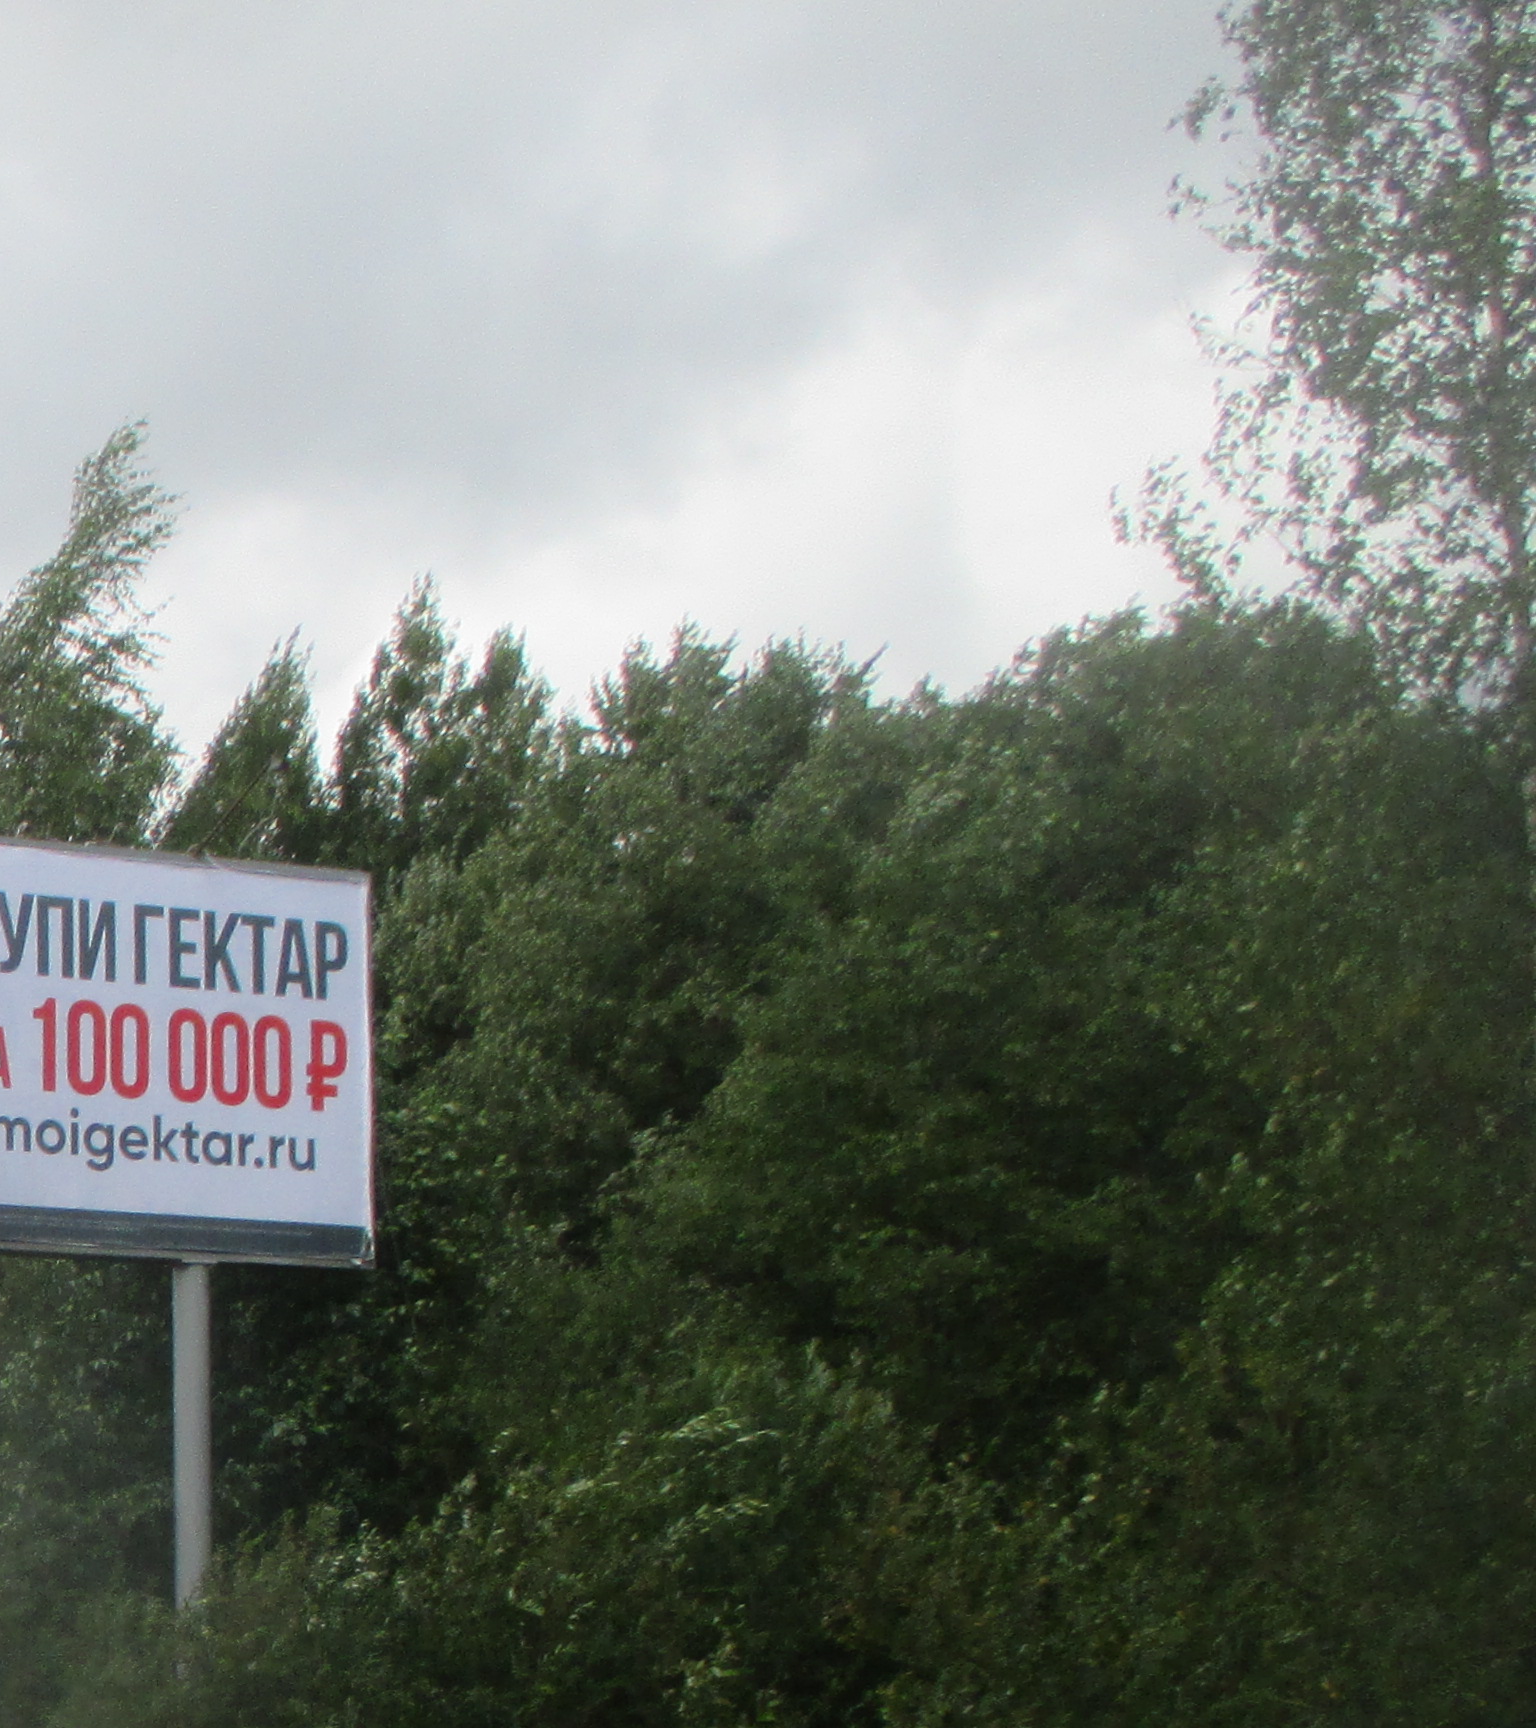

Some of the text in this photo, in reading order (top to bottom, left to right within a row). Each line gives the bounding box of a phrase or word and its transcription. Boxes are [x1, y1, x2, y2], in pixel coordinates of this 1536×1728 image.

[134, 904, 349, 1000] ГЕКТАР
[33, 997, 150, 1099] 100
[167, 1007, 292, 1109] 000
